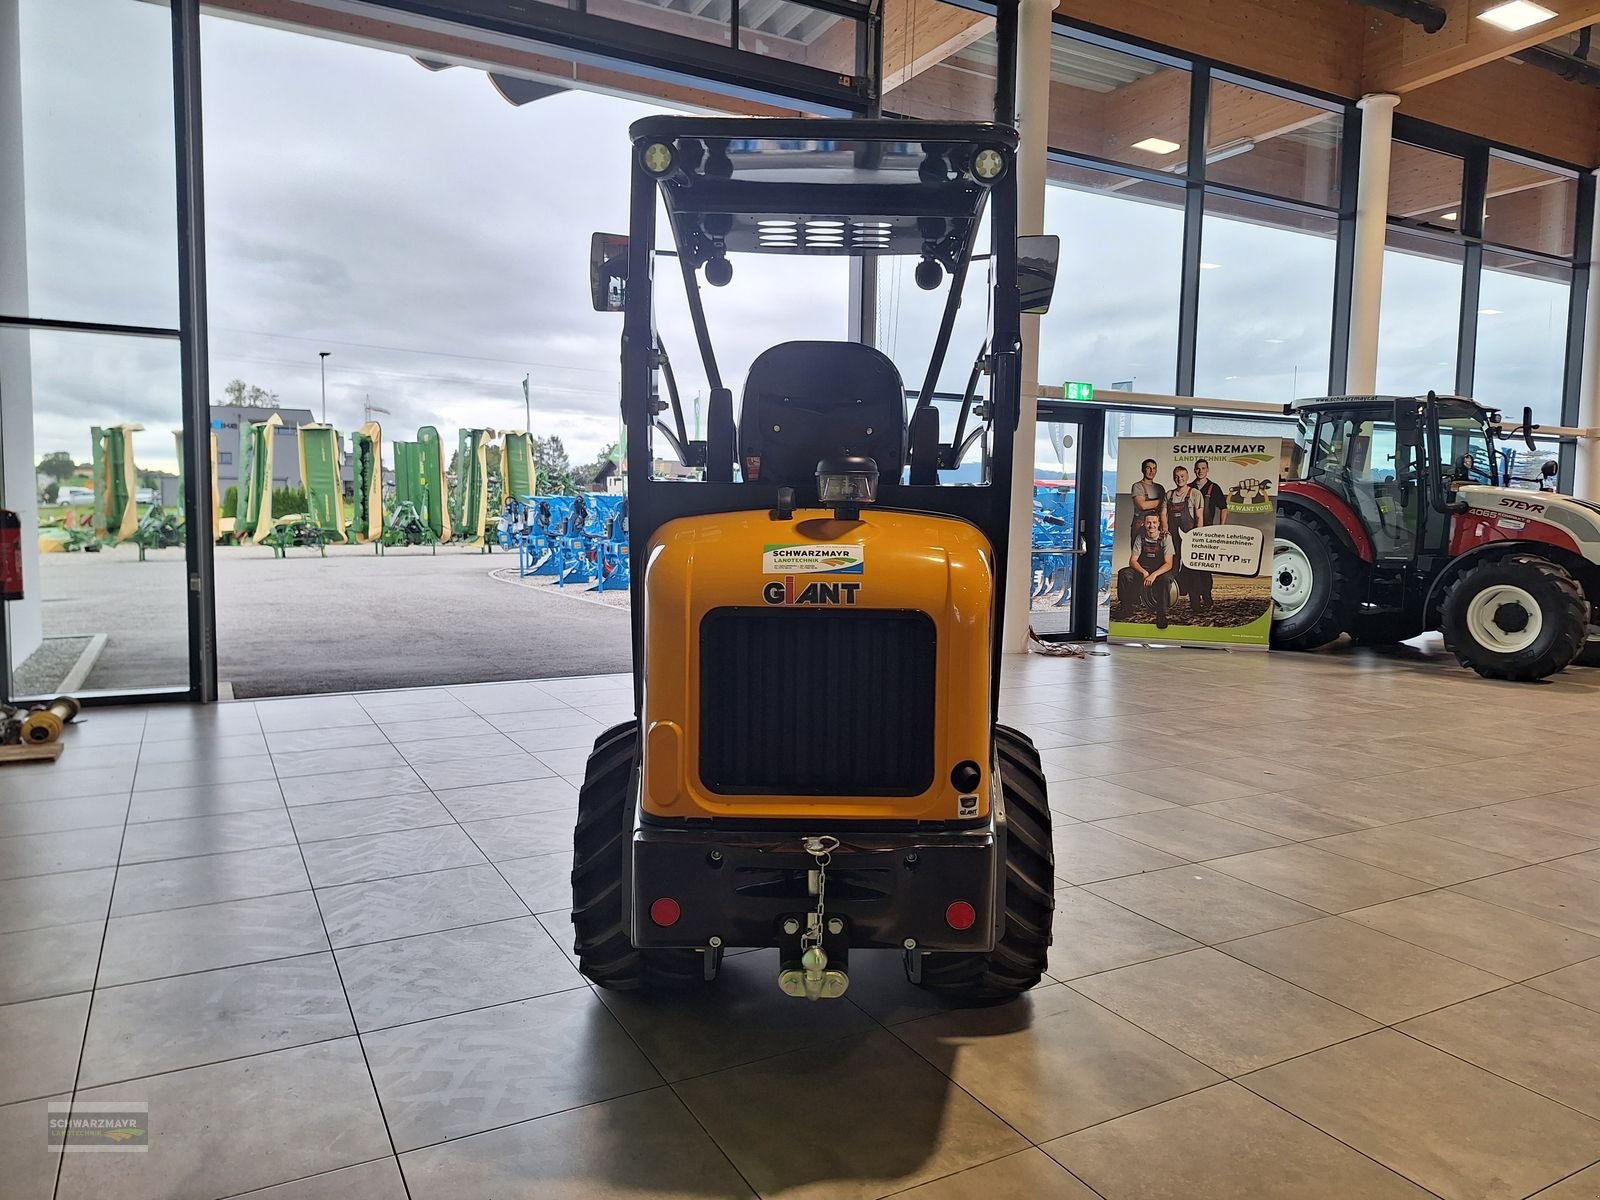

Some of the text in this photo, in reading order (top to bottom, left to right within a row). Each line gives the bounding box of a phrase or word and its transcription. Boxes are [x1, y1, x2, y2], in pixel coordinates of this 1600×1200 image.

[1173, 445, 1265, 454] SCHWARZMAYR
[1498, 498, 1545, 514] STEYR
[1469, 509, 1498, 519] 4065
[1206, 538, 1254, 546] Landmaschinen-
[1191, 552, 1215, 561] DEIN
[1218, 554, 1240, 562] TYP
